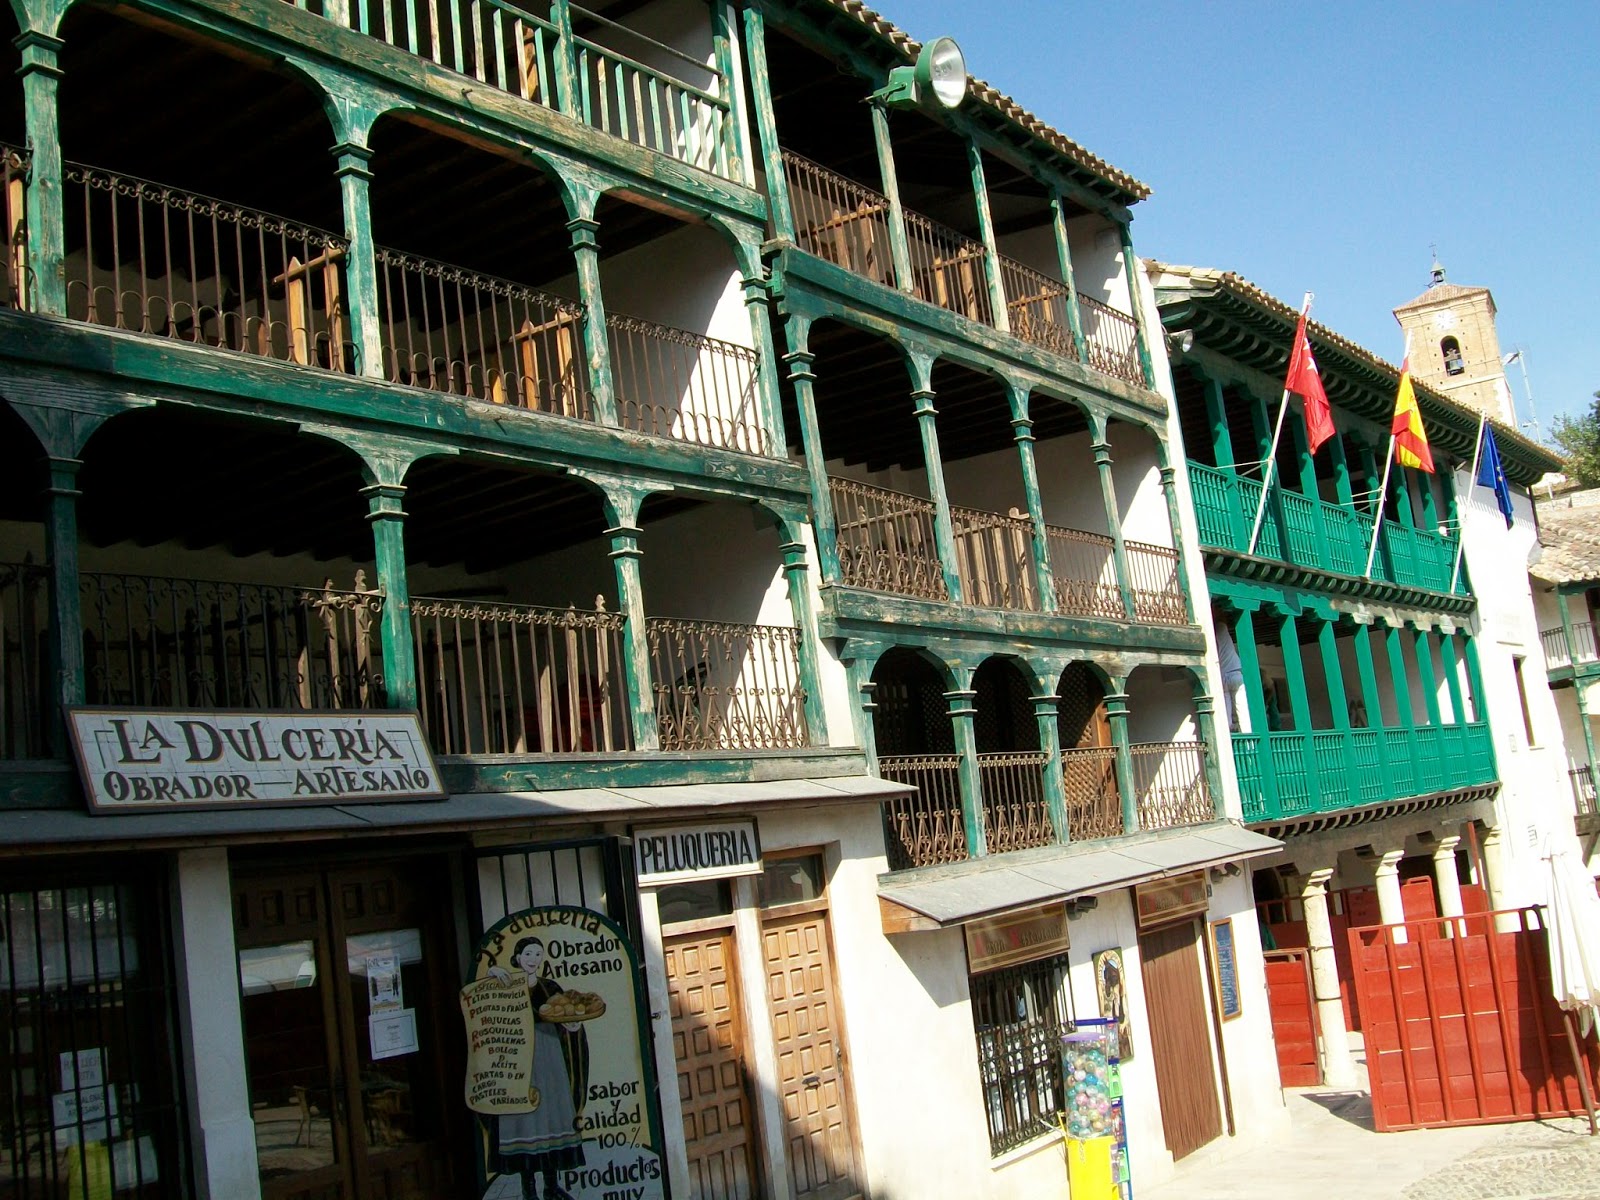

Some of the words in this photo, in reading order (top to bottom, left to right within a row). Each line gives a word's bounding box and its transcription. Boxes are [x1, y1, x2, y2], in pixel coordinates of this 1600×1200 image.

[109, 720, 176, 764] LA
[104, 771, 256, 802] OBRADOR
[294, 765, 430, 796] ARTESANO
[638, 829, 754, 875] PELUQUERIA
[548, 934, 622, 960] Obrador
[542, 958, 624, 980] Artesano
[488, 1046, 518, 1055] BOLLOS
